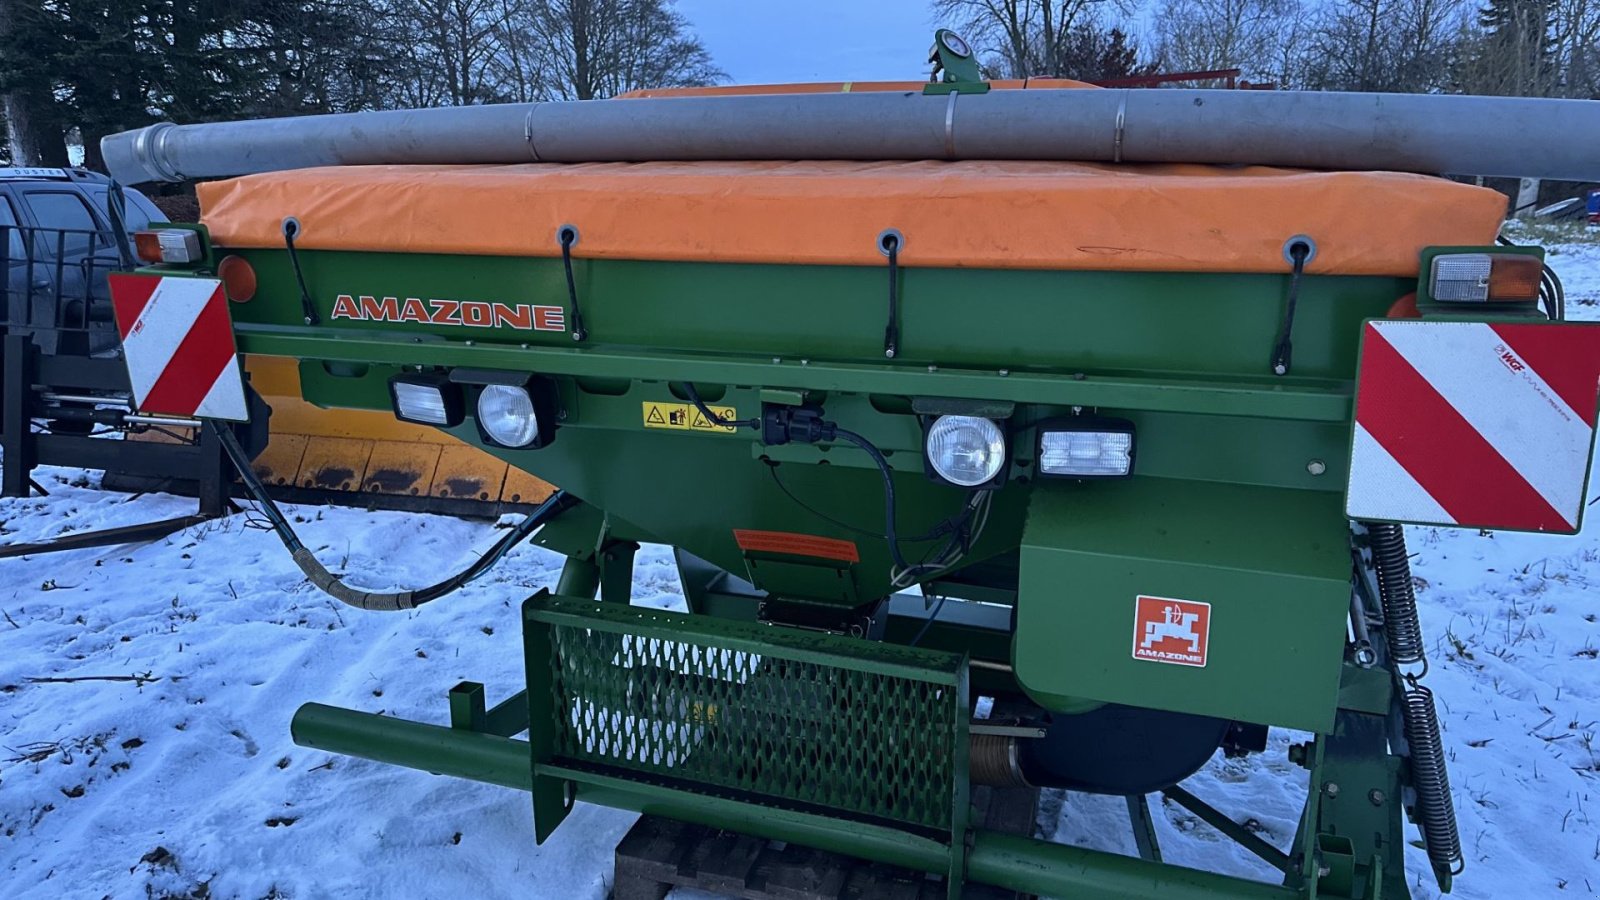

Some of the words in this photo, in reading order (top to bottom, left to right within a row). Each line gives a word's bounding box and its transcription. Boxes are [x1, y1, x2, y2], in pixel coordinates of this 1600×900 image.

[331, 294, 566, 332] AMAZONE
[1501, 351, 1526, 372] WGF
[1136, 648, 1202, 663] AMAZONE
